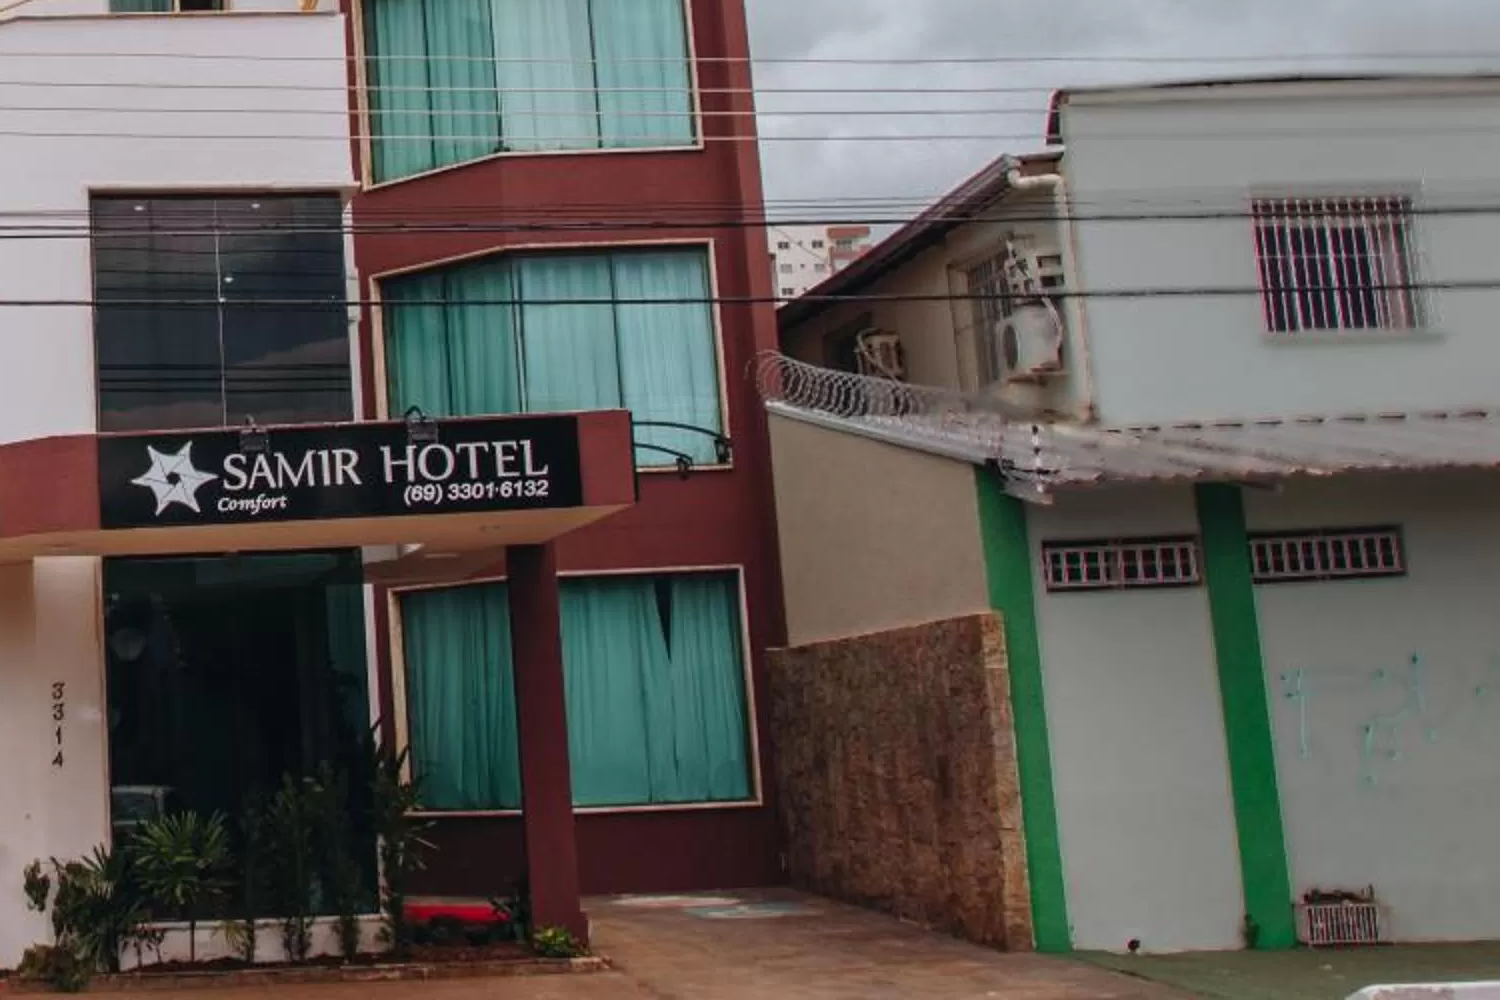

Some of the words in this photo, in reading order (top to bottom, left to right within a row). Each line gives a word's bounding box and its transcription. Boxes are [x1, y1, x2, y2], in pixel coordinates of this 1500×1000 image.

[223, 448, 363, 490] SAMIR
[380, 439, 549, 483] HOTEL
[217, 493, 288, 515] Comfort
[404, 483, 443, 506] (69)
